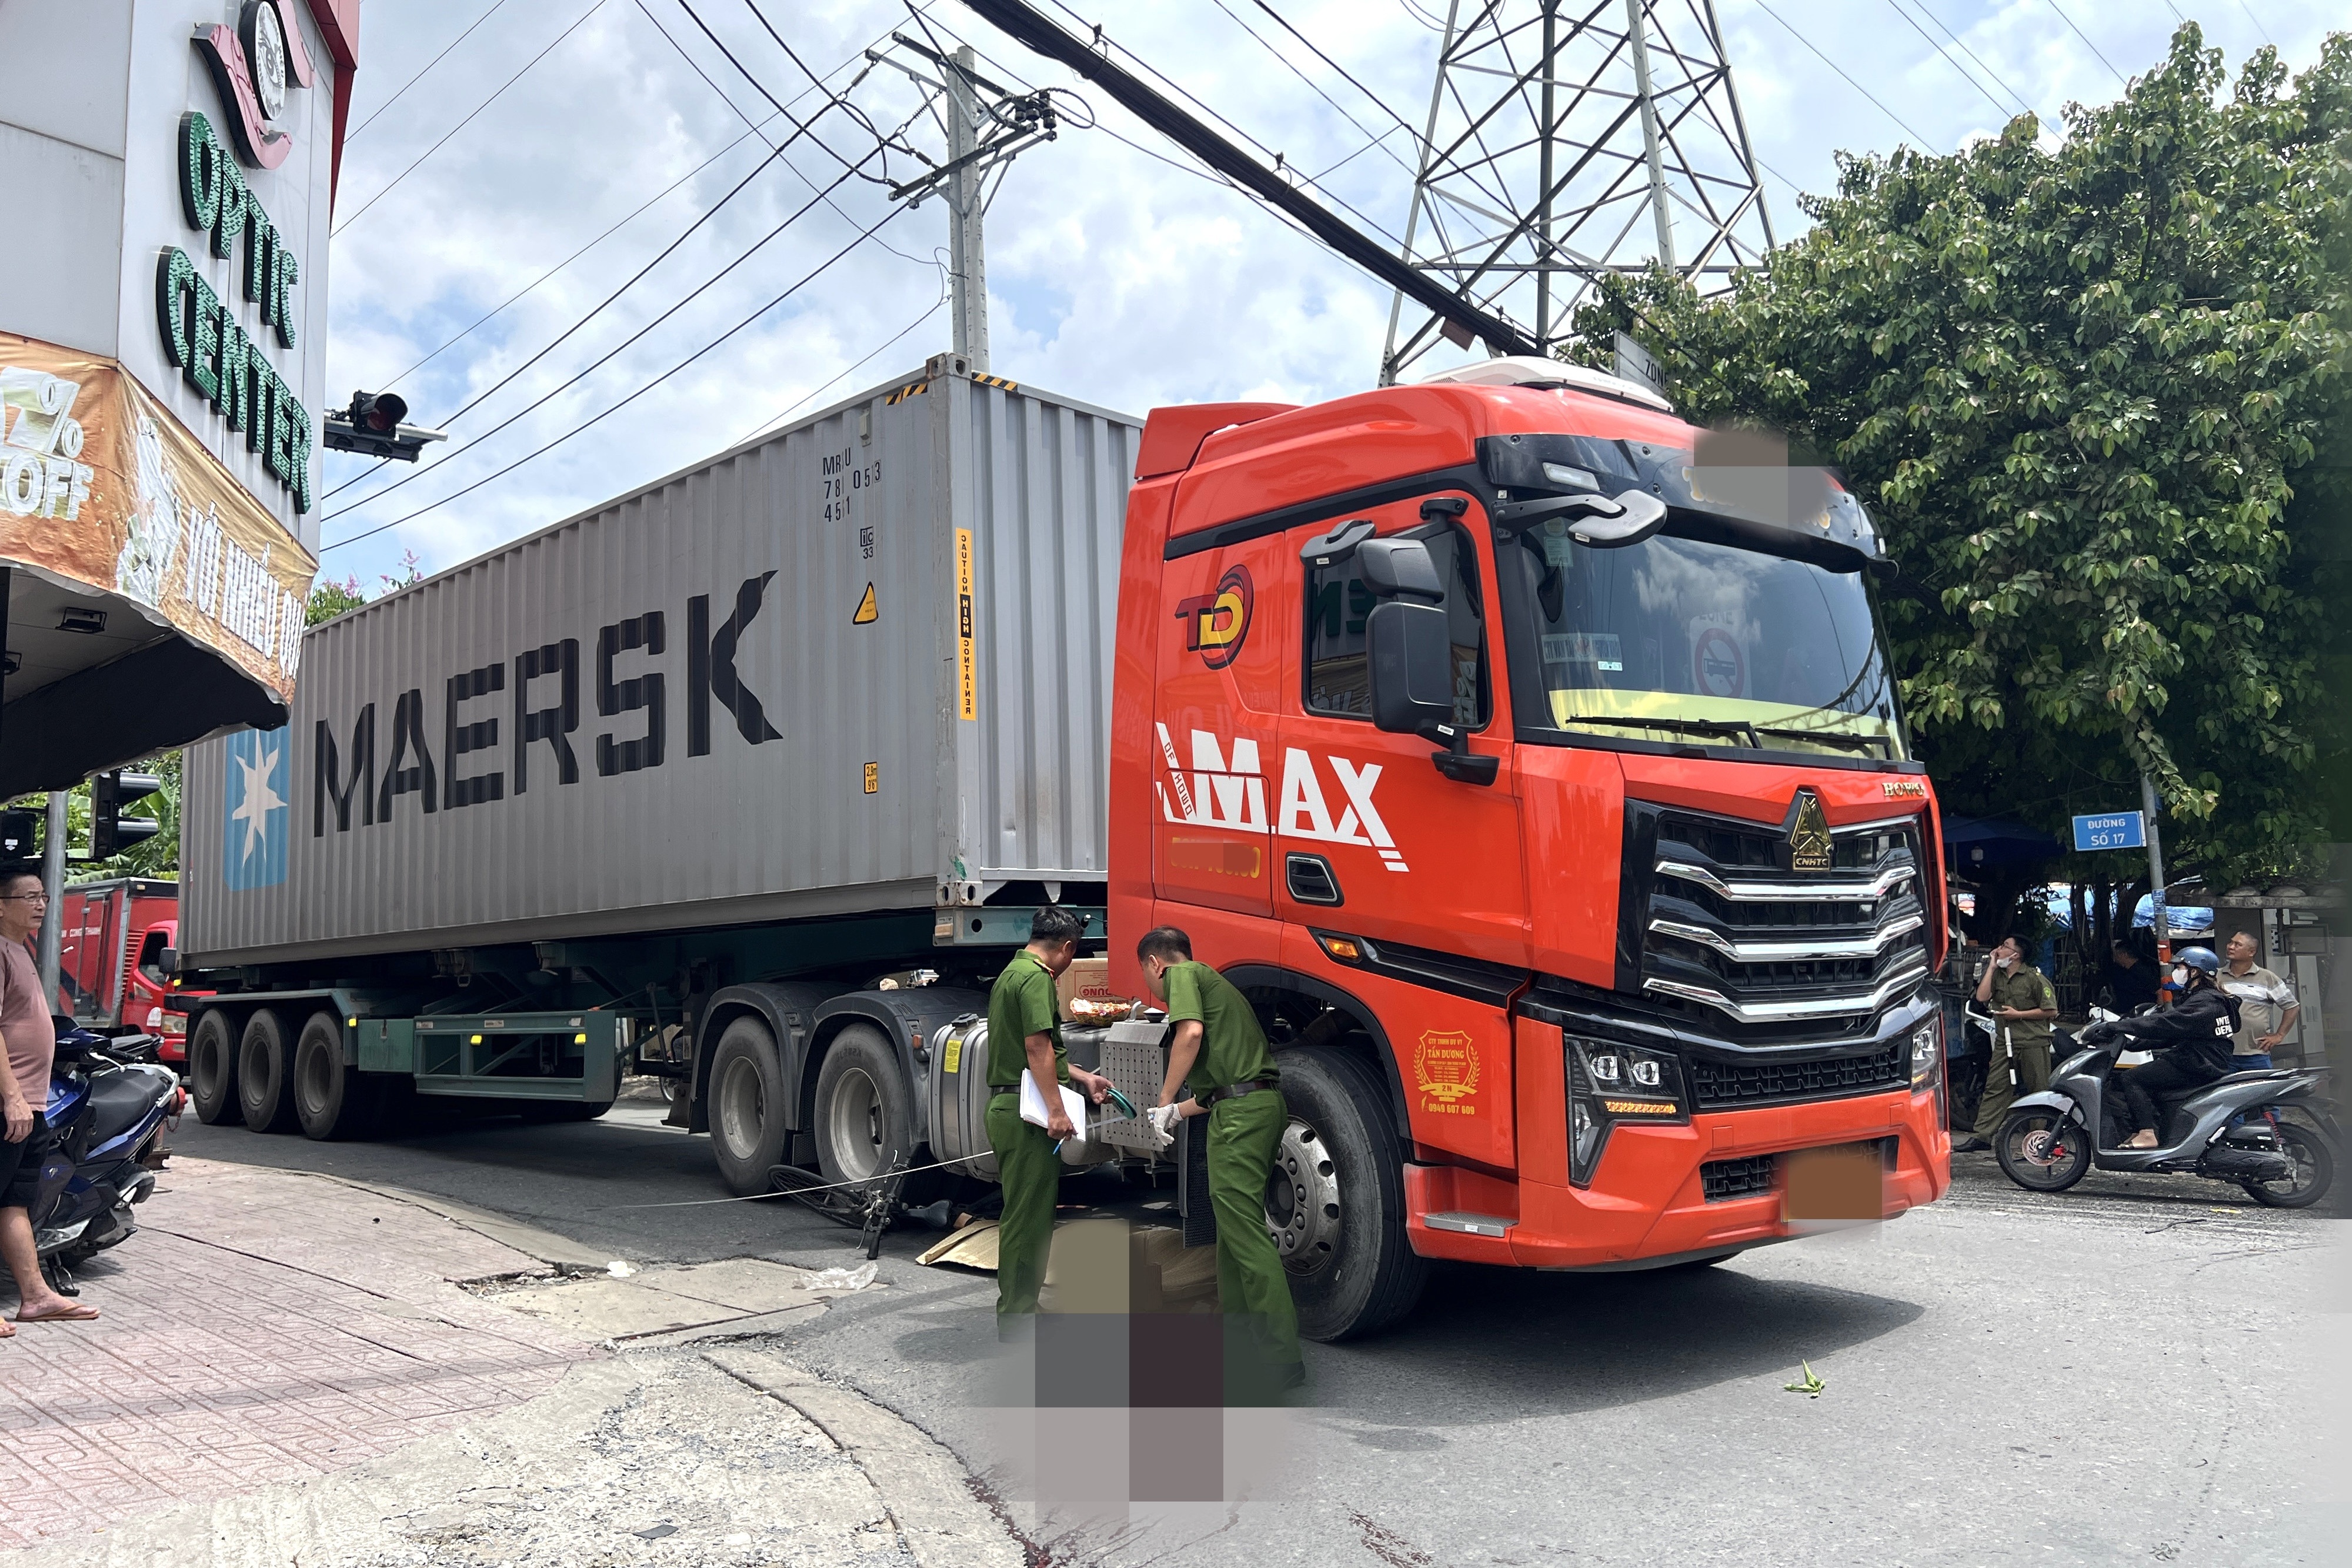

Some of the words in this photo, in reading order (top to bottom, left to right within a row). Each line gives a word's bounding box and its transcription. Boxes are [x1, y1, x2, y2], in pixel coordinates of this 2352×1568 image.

[181, 111, 299, 349] OPTIC
[158, 246, 312, 515] CENTER
[0, 366, 84, 459] 7%
[823, 447, 851, 476] MRU
[824, 496, 850, 522] 451
[863, 546, 874, 559] 33
[313, 569, 783, 838] MAERSK
[1164, 741, 1176, 761] OF
[1174, 773, 1193, 816] HOWO
[1189, 729, 1396, 848] MAX
[2087, 818, 2126, 829] ĐƯỜNG
[2091, 829, 2109, 846] SỐ
[2113, 833, 2125, 844] 17
[1795, 857, 1829, 866] CNHTC
[1980, 1022, 1996, 1032] CSGT
[1429, 1103, 1445, 1113] 0949
[1446, 1104, 1460, 1114] 607
[1461, 1105, 1475, 1115] 609
